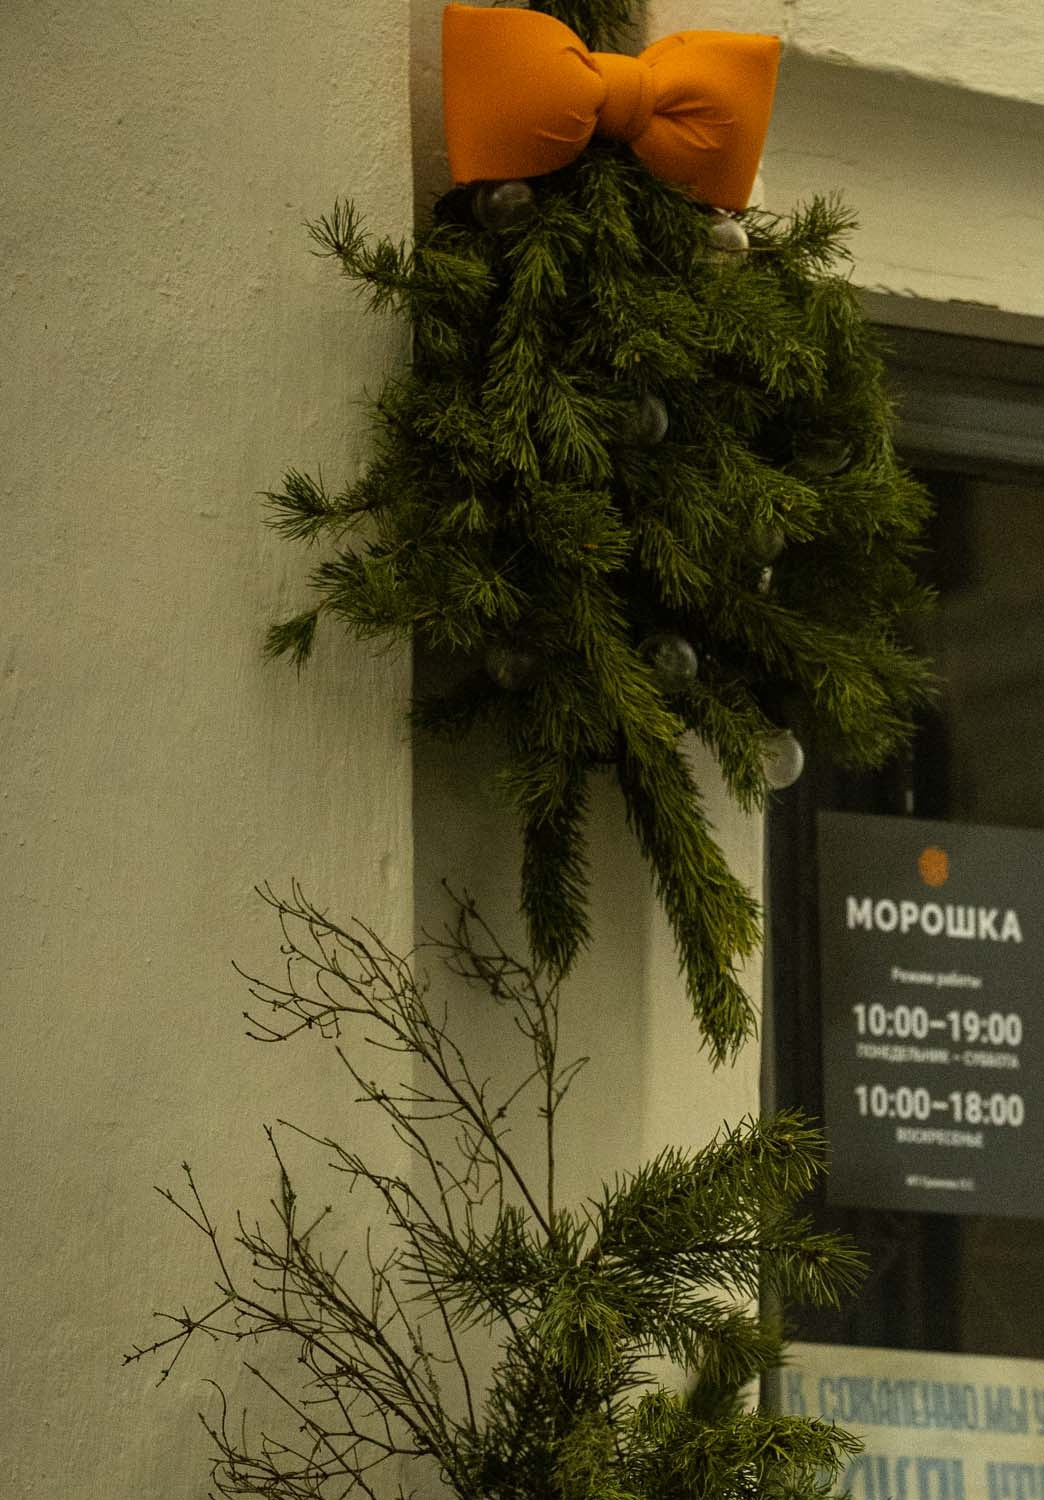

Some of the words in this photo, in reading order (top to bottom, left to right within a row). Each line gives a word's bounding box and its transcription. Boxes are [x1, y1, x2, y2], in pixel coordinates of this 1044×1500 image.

[846, 897, 1023, 943] МОРОШКА
[852, 1003, 1023, 1046] 10:00–19:00
[856, 1042, 949, 1064] ПОНЕДЕЛЬНИК
[962, 1050, 1020, 1069] СУББОТА
[854, 1084, 1025, 1127] 10:00–18:00
[817, 1376, 980, 1430] СОЖАЛЕНИЮ
[983, 1383, 1030, 1435] МЫ
